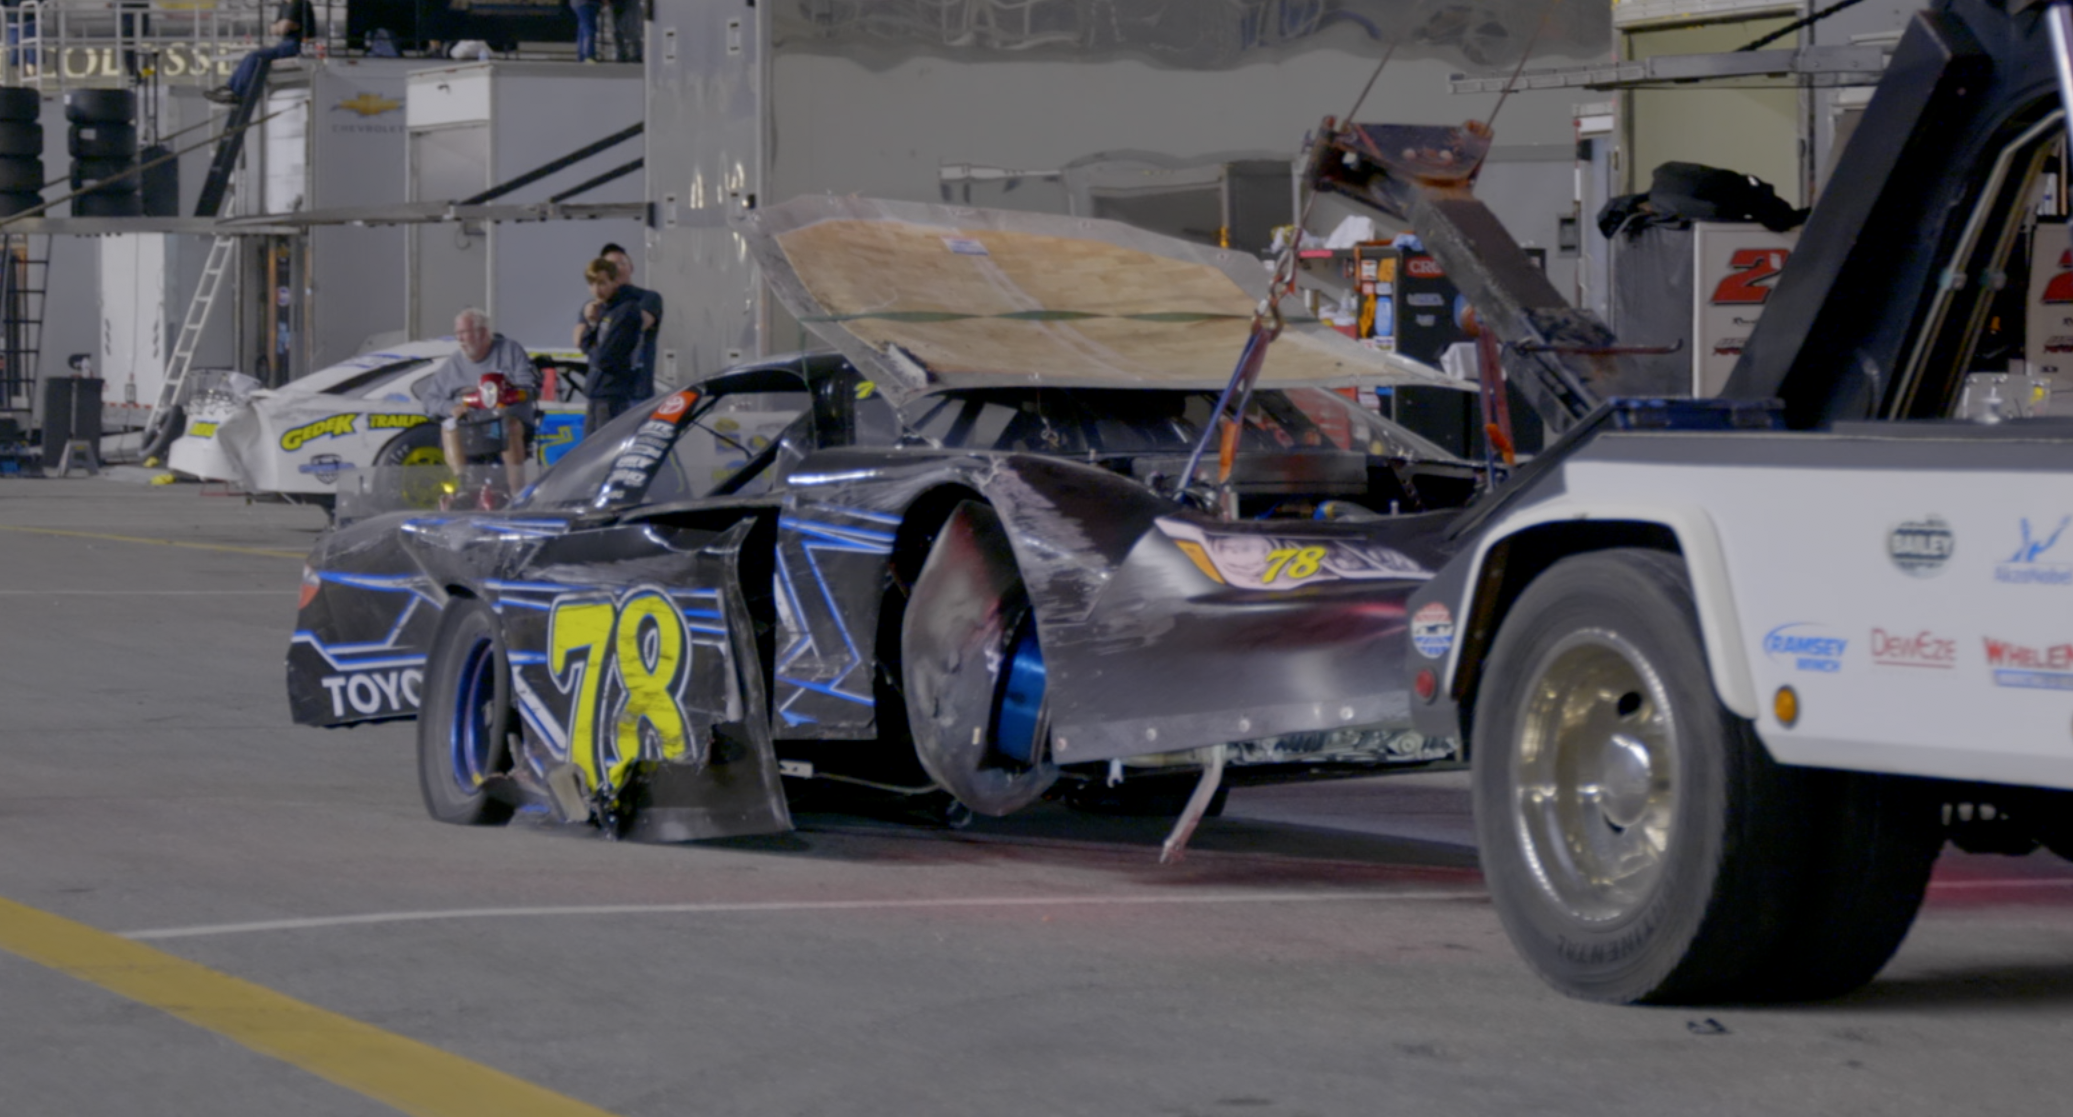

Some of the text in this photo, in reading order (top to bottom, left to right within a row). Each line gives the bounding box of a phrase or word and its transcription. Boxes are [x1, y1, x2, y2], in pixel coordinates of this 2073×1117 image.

[280, 413, 359, 451] GEDEK
[1261, 545, 1326, 584] 78
[1768, 634, 1849, 656] RAMSEY
[549, 584, 698, 794] 78
